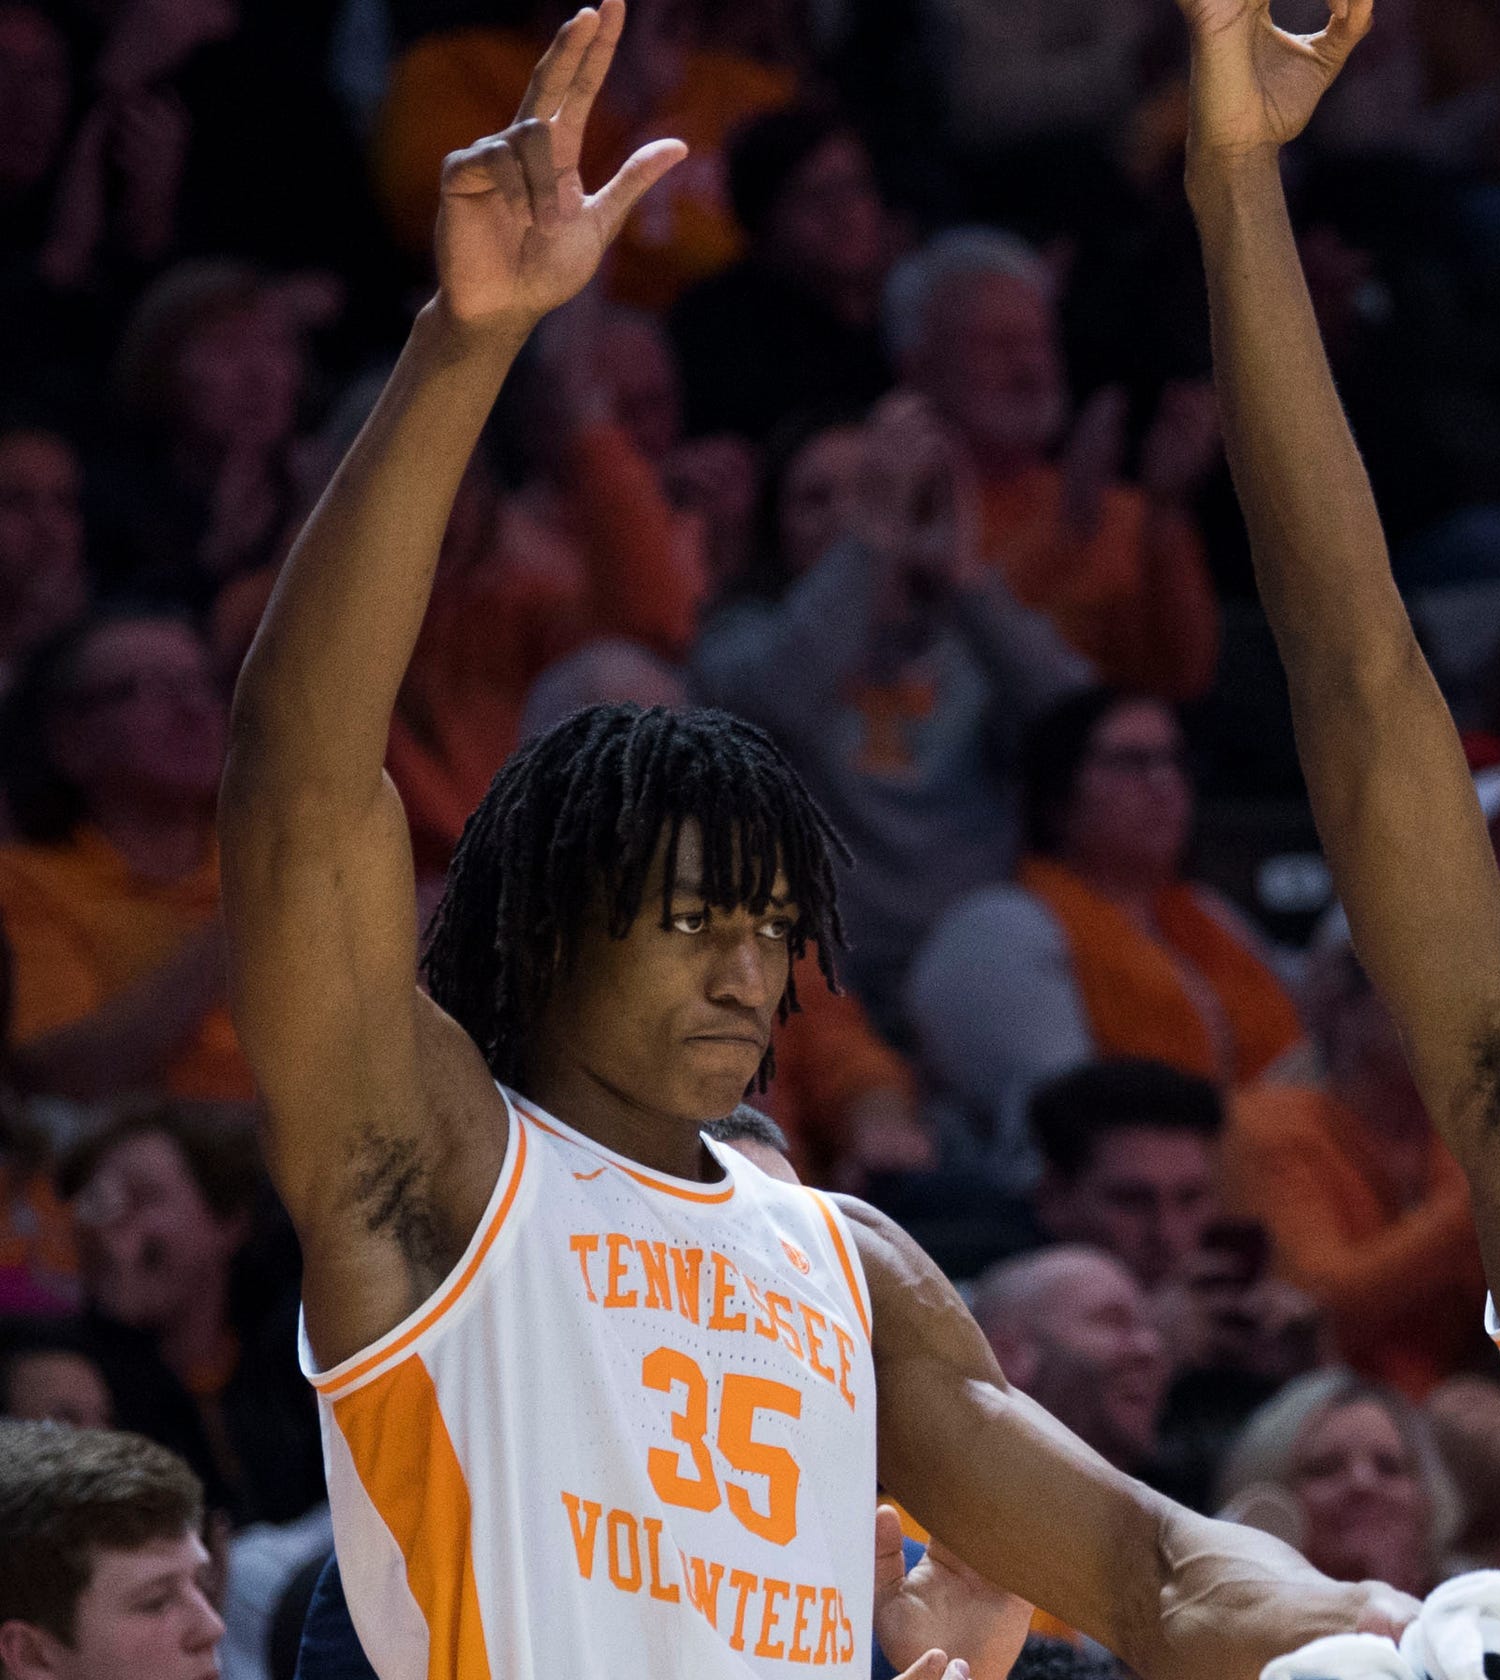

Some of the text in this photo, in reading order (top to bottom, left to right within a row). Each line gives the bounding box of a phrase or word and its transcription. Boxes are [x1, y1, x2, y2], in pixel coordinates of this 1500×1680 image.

[569, 1233, 855, 1413] TENNESSEE
[642, 1346, 802, 1546] 35
[561, 1491, 854, 1664] VOLNTEERS
